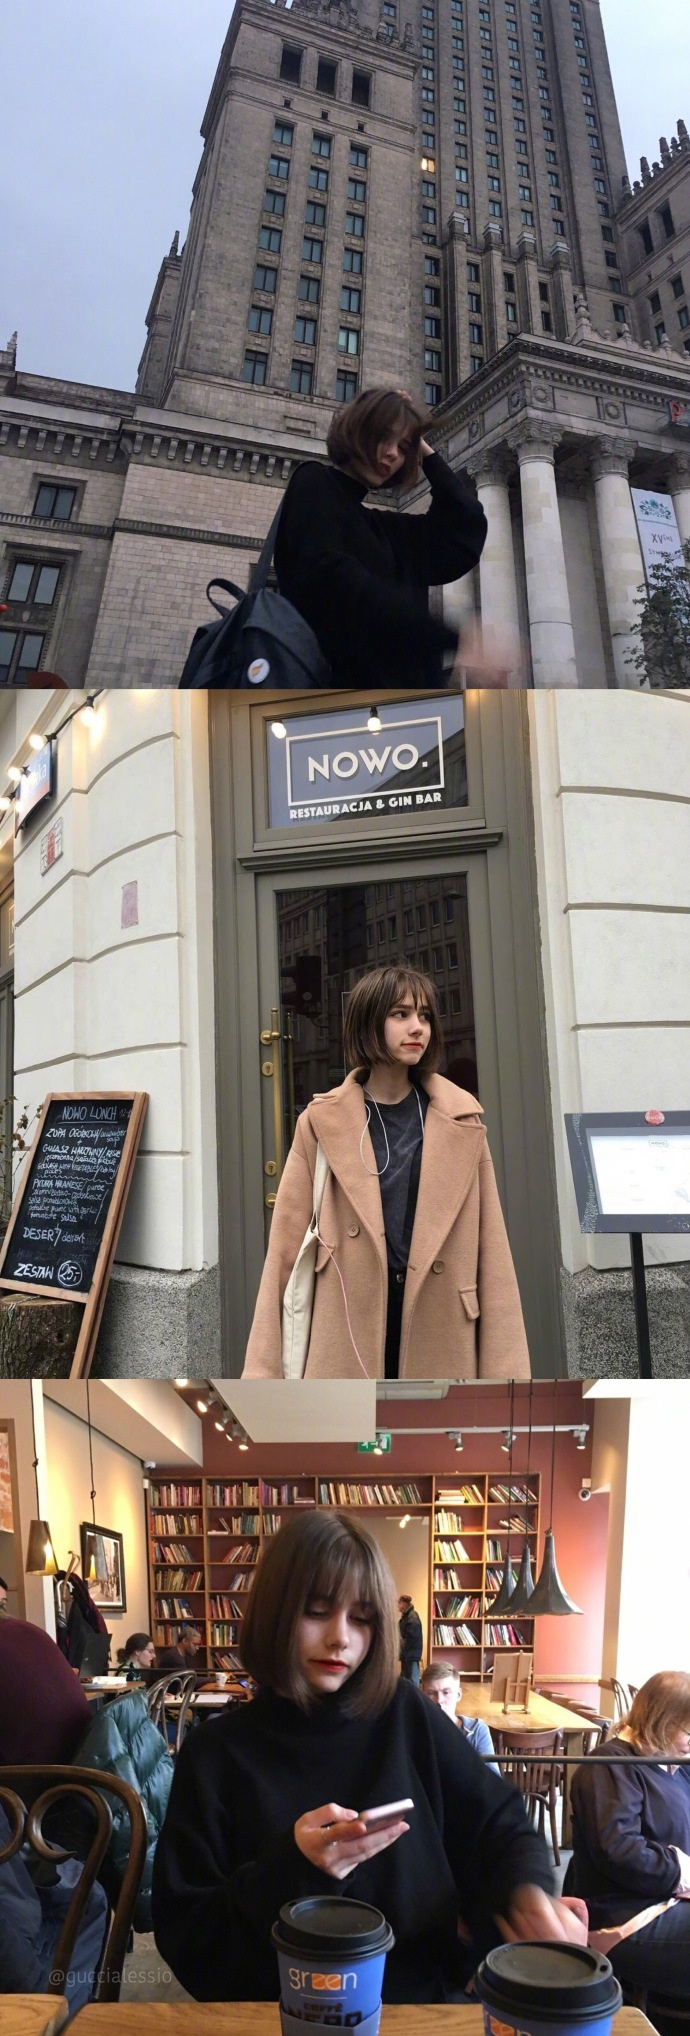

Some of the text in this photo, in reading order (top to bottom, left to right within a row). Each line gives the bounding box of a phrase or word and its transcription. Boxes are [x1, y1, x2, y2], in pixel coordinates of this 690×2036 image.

[308, 743, 428, 782] NOWO.
[289, 792, 442, 820] RESTAURACJA & GIN BAR
[62, 1105, 88, 1121] NOWO
[90, 1105, 117, 1121] LUNCH
[45, 1127, 67, 1138] ZUPA
[42, 1143, 70, 1154] GULASZ
[13, 1262, 55, 1280] ZESTAW
[288, 1967, 358, 1990] green
